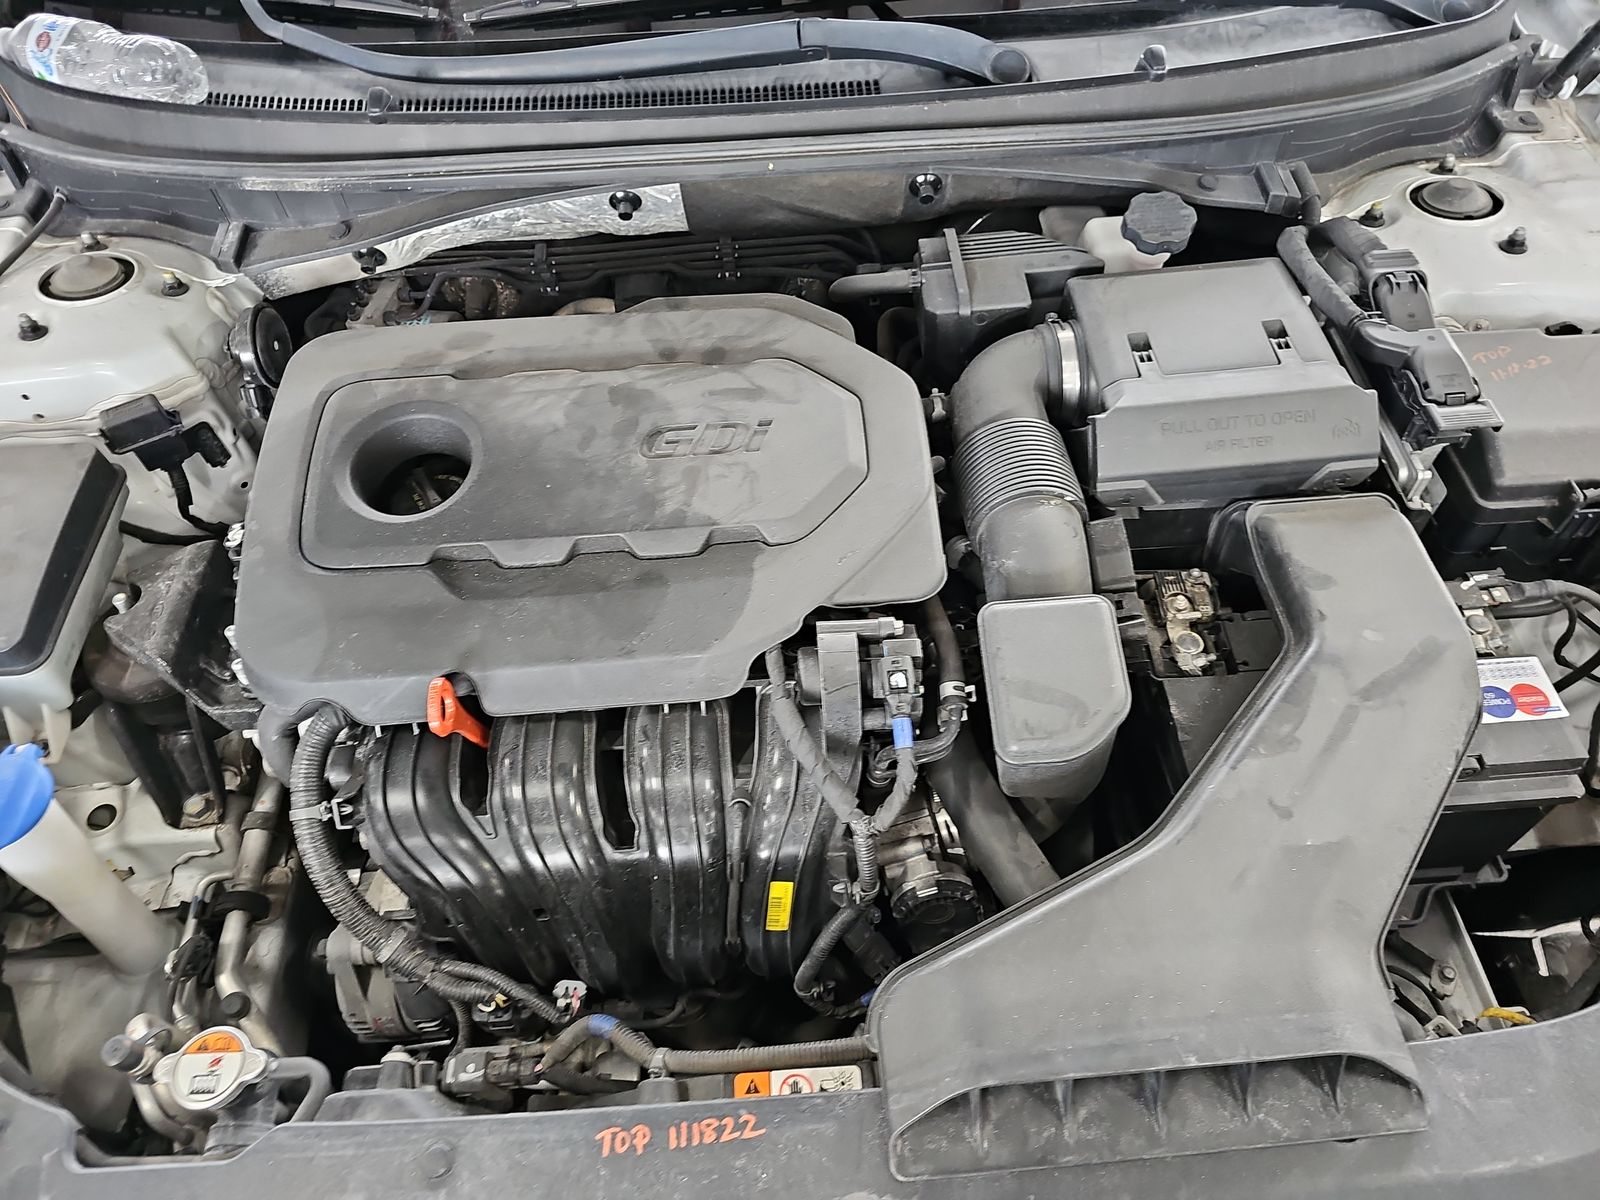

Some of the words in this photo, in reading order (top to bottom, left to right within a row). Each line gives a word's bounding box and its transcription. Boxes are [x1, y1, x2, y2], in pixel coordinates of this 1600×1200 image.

[1472, 345, 1512, 363] TOP
[1160, 421, 1202, 436] PULL
[1207, 416, 1239, 431] OUT
[1245, 413, 1266, 428] TO
[1271, 409, 1316, 425] OPEN
[639, 418, 773, 459] GDi
[1204, 439, 1226, 451] AIR
[1231, 435, 1274, 449] FILTER
[594, 1123, 651, 1158] TOP
[668, 1113, 767, 1150] 111822
